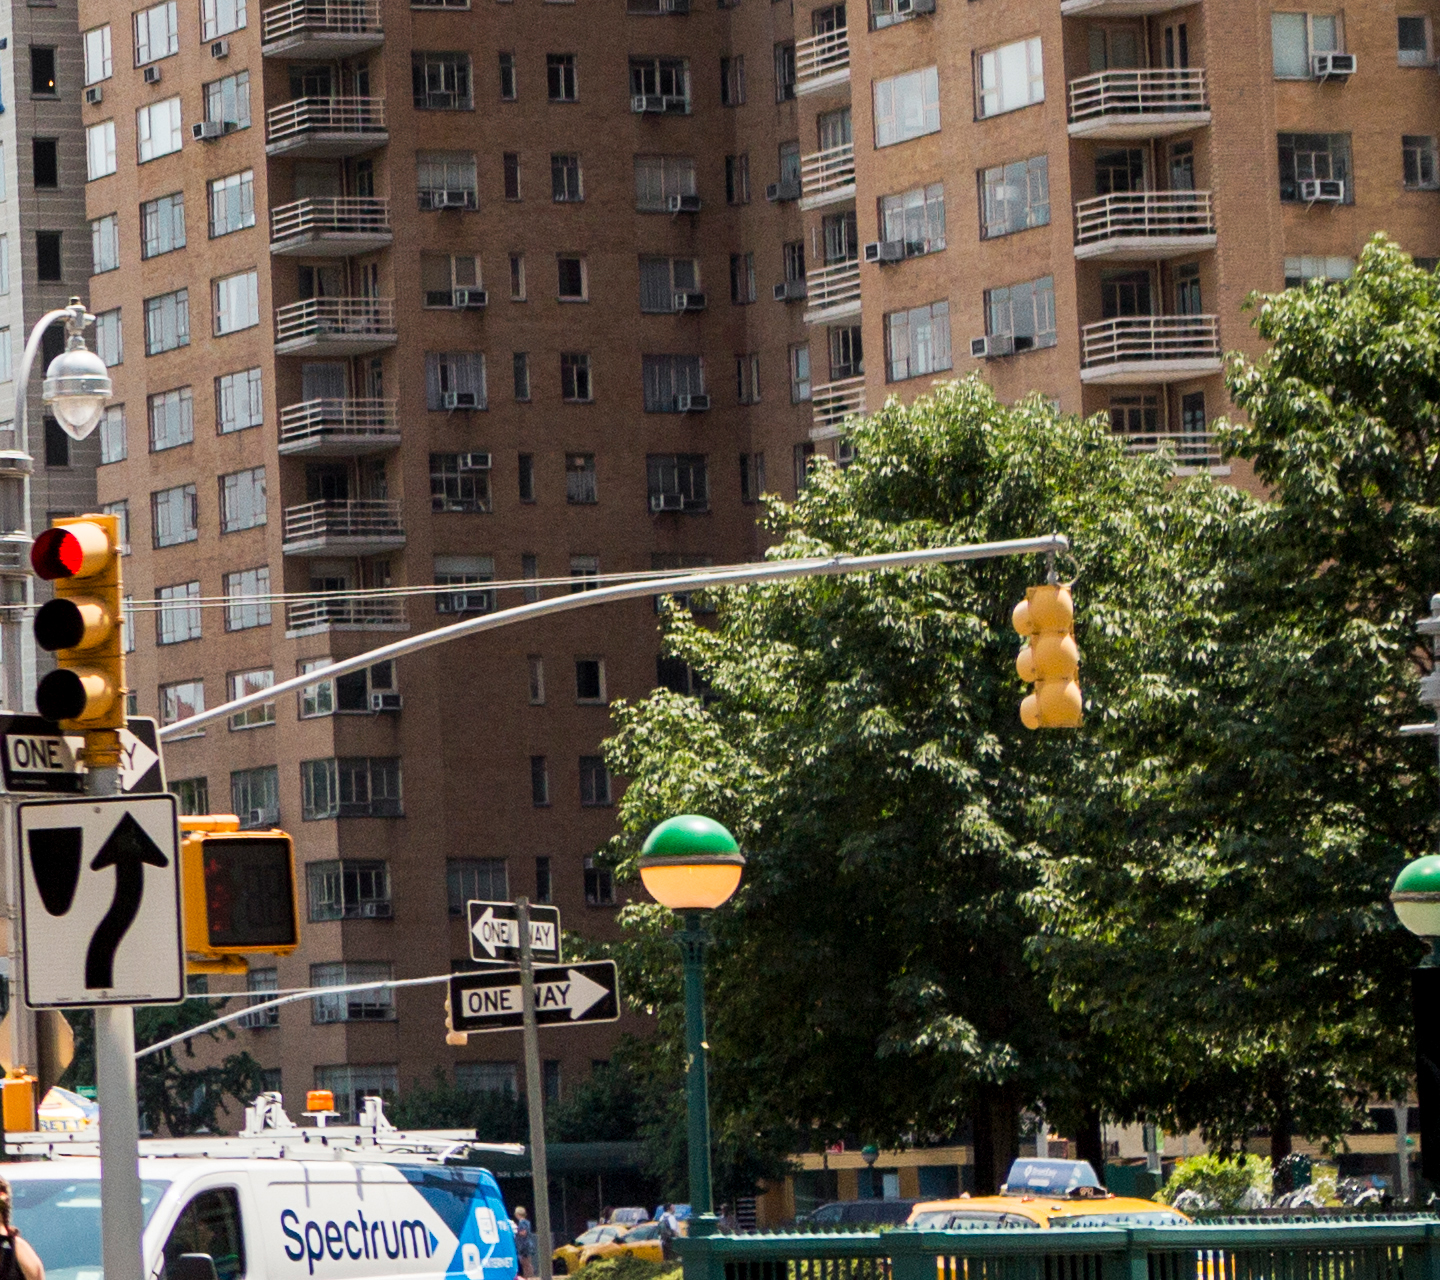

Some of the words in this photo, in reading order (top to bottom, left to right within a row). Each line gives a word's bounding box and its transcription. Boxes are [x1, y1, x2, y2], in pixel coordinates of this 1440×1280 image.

[13, 738, 63, 769] ONE
[482, 921, 510, 944] ONE
[468, 989, 513, 1014] ONE
[280, 1209, 430, 1276] Spectrum
